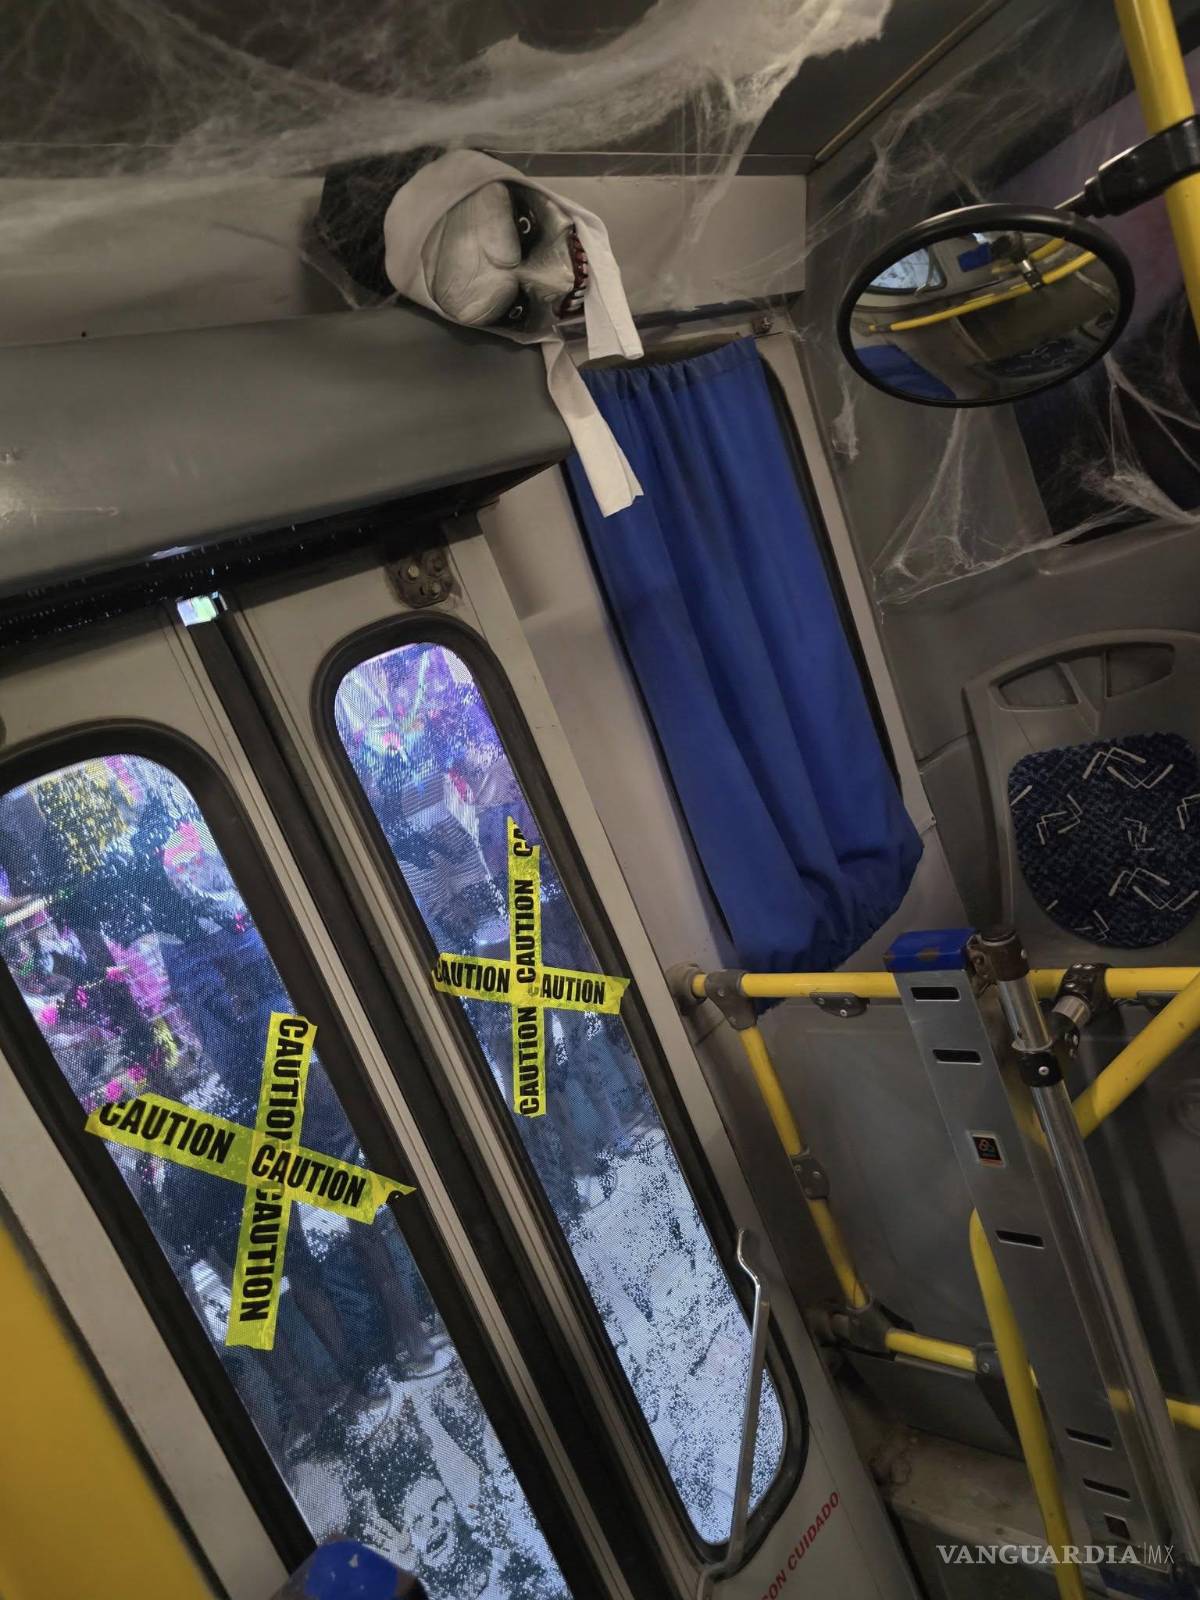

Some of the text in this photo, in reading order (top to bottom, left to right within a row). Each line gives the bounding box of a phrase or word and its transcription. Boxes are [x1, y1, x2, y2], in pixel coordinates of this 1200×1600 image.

[434, 960, 511, 995] CAUTION
[514, 879, 537, 984] CAUTION
[518, 1006, 540, 1117] CAUTION
[98, 1102, 367, 1208] CAUTION CAUTION
[788, 1491, 839, 1571] CUIDADO
